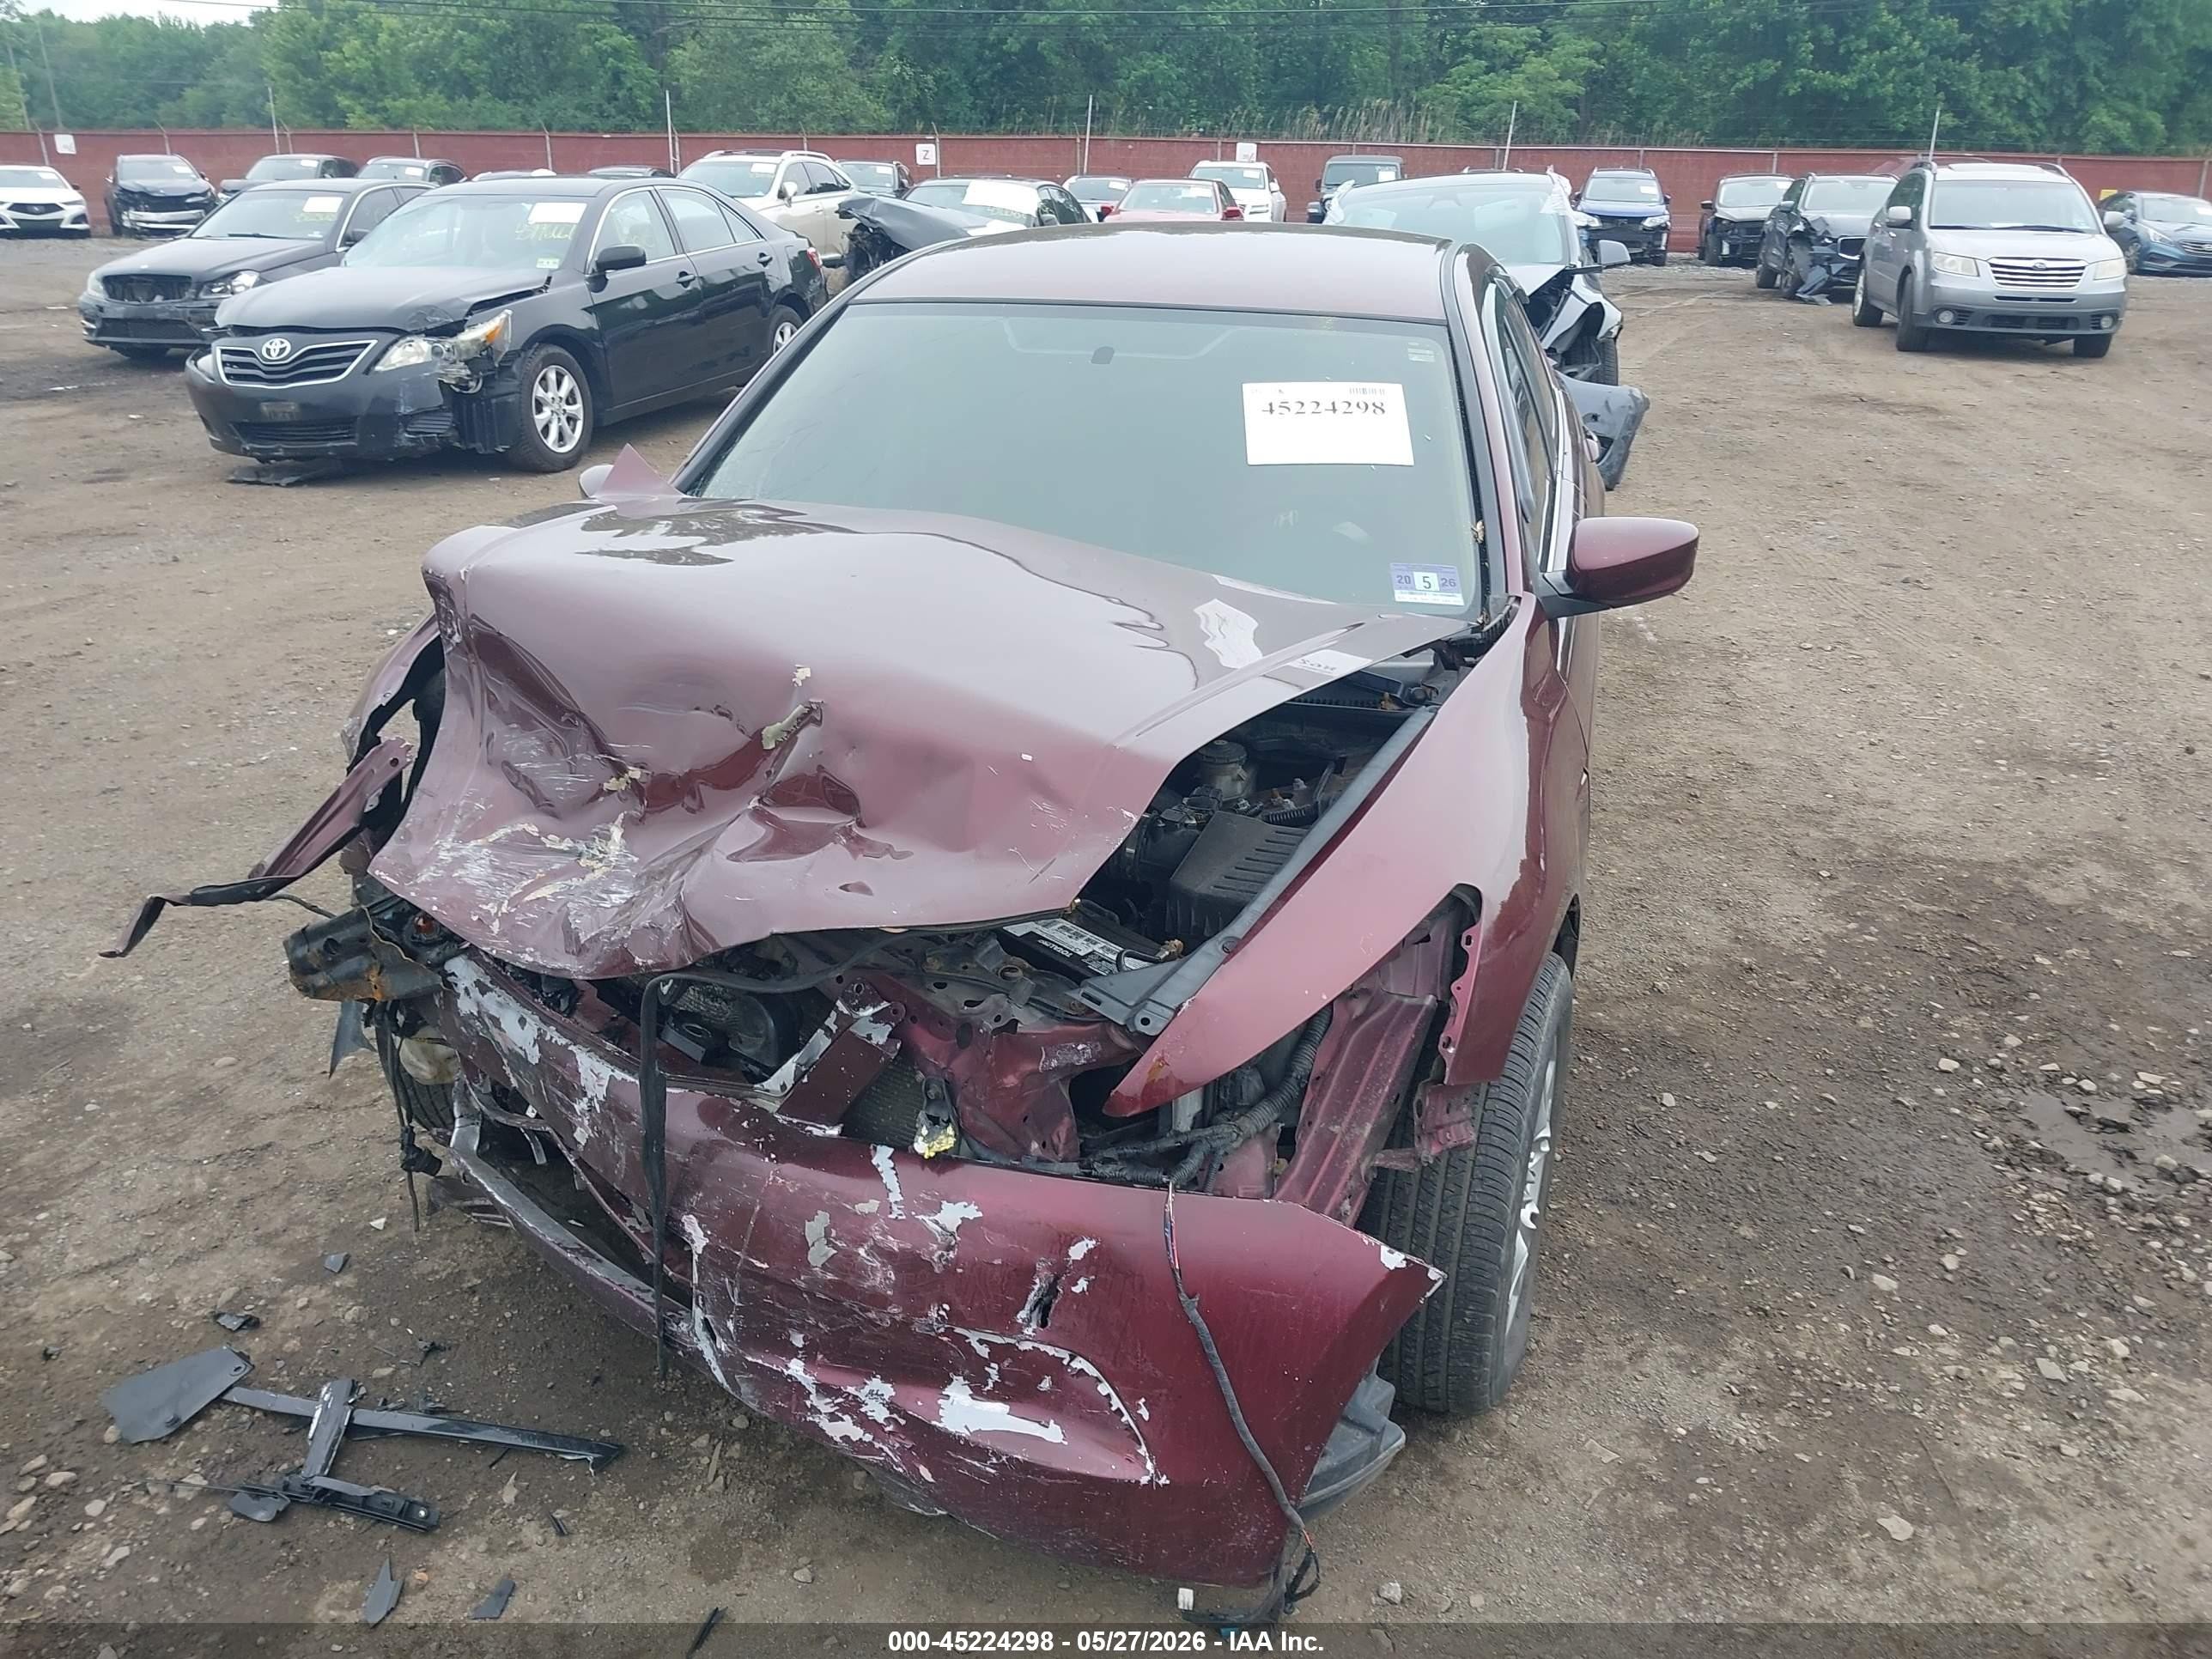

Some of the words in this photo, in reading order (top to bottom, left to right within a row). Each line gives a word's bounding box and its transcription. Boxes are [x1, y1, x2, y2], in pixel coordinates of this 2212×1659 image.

[922, 150, 930, 160] Z
[1261, 400, 1386, 415] 45224298
[1396, 575, 1411, 585] 20
[1422, 576, 1431, 589] 5
[1440, 578, 1456, 587] 26
